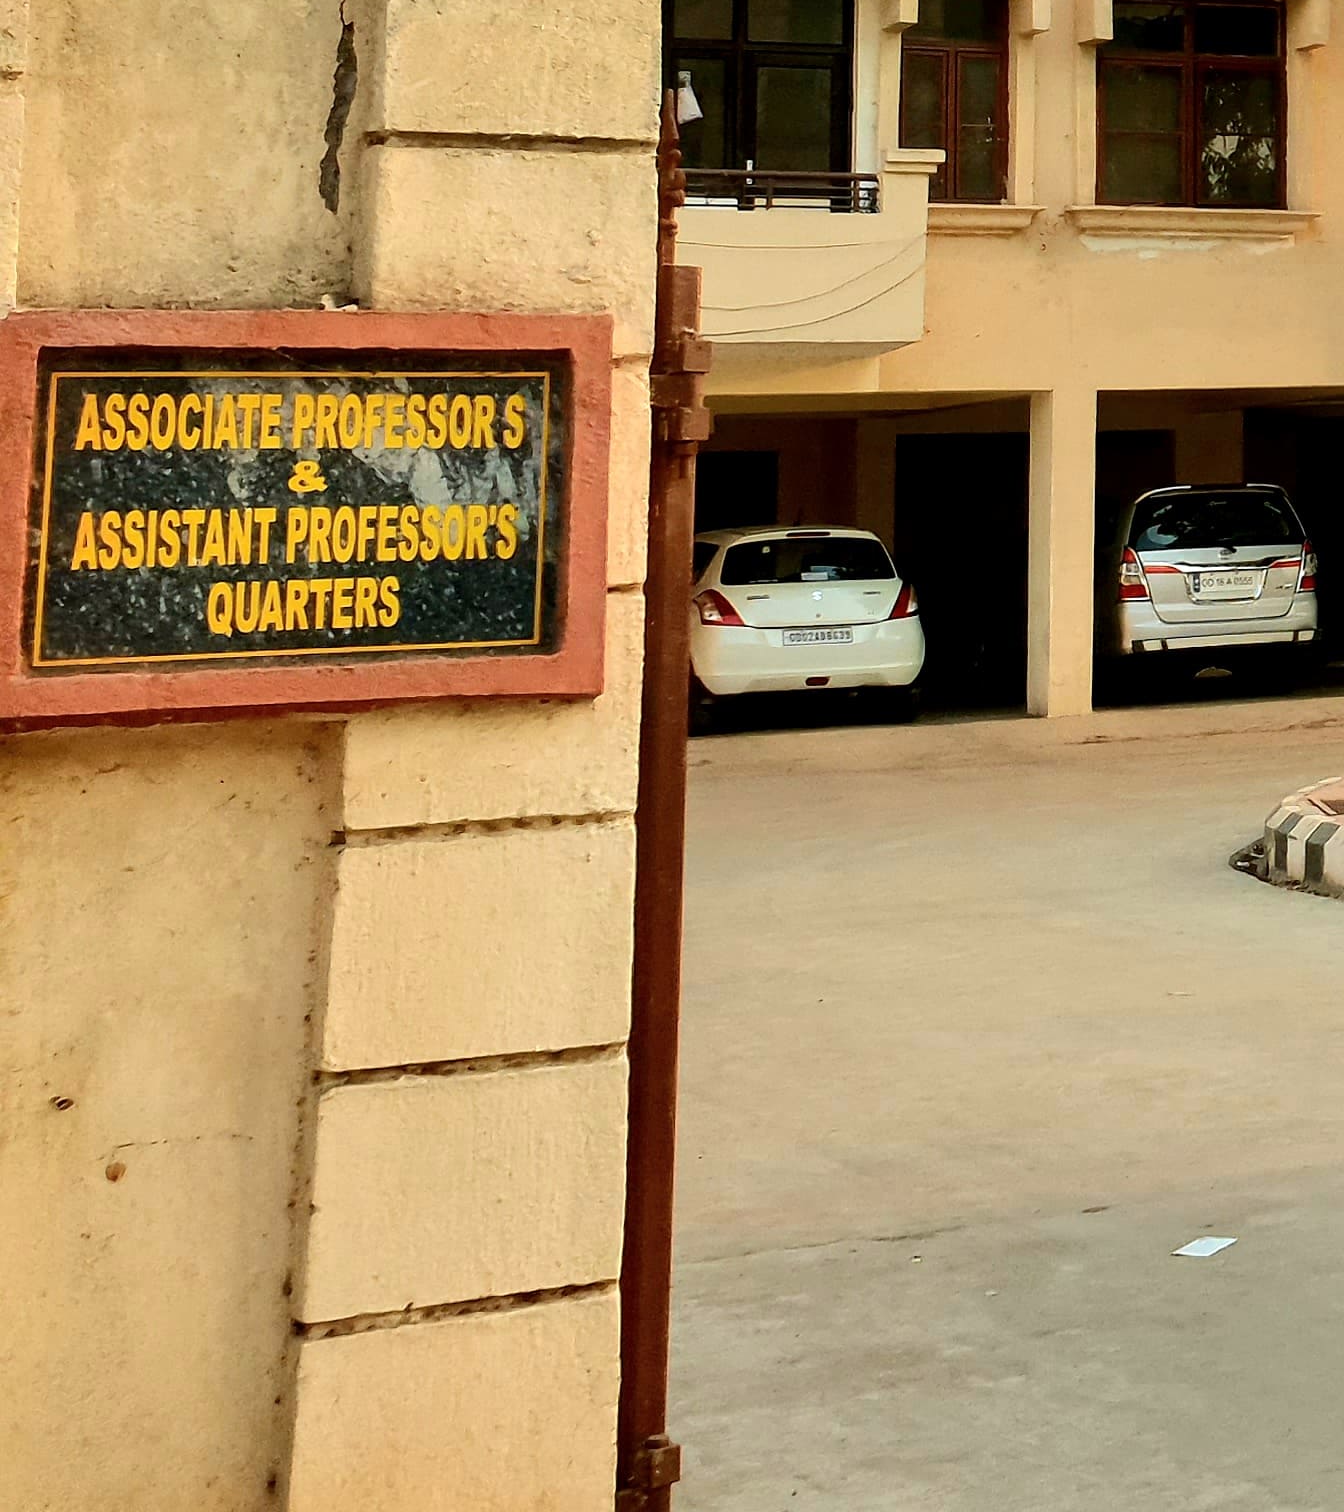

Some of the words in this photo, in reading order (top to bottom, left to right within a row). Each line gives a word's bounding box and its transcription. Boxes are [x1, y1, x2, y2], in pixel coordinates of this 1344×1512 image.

[74, 392, 282, 451] ASSOCIATE
[287, 459, 329, 494] &
[70, 506, 278, 572] ASSISTANT
[285, 502, 520, 565] PROFESSOR'S
[206, 574, 402, 637] QUARTERS
